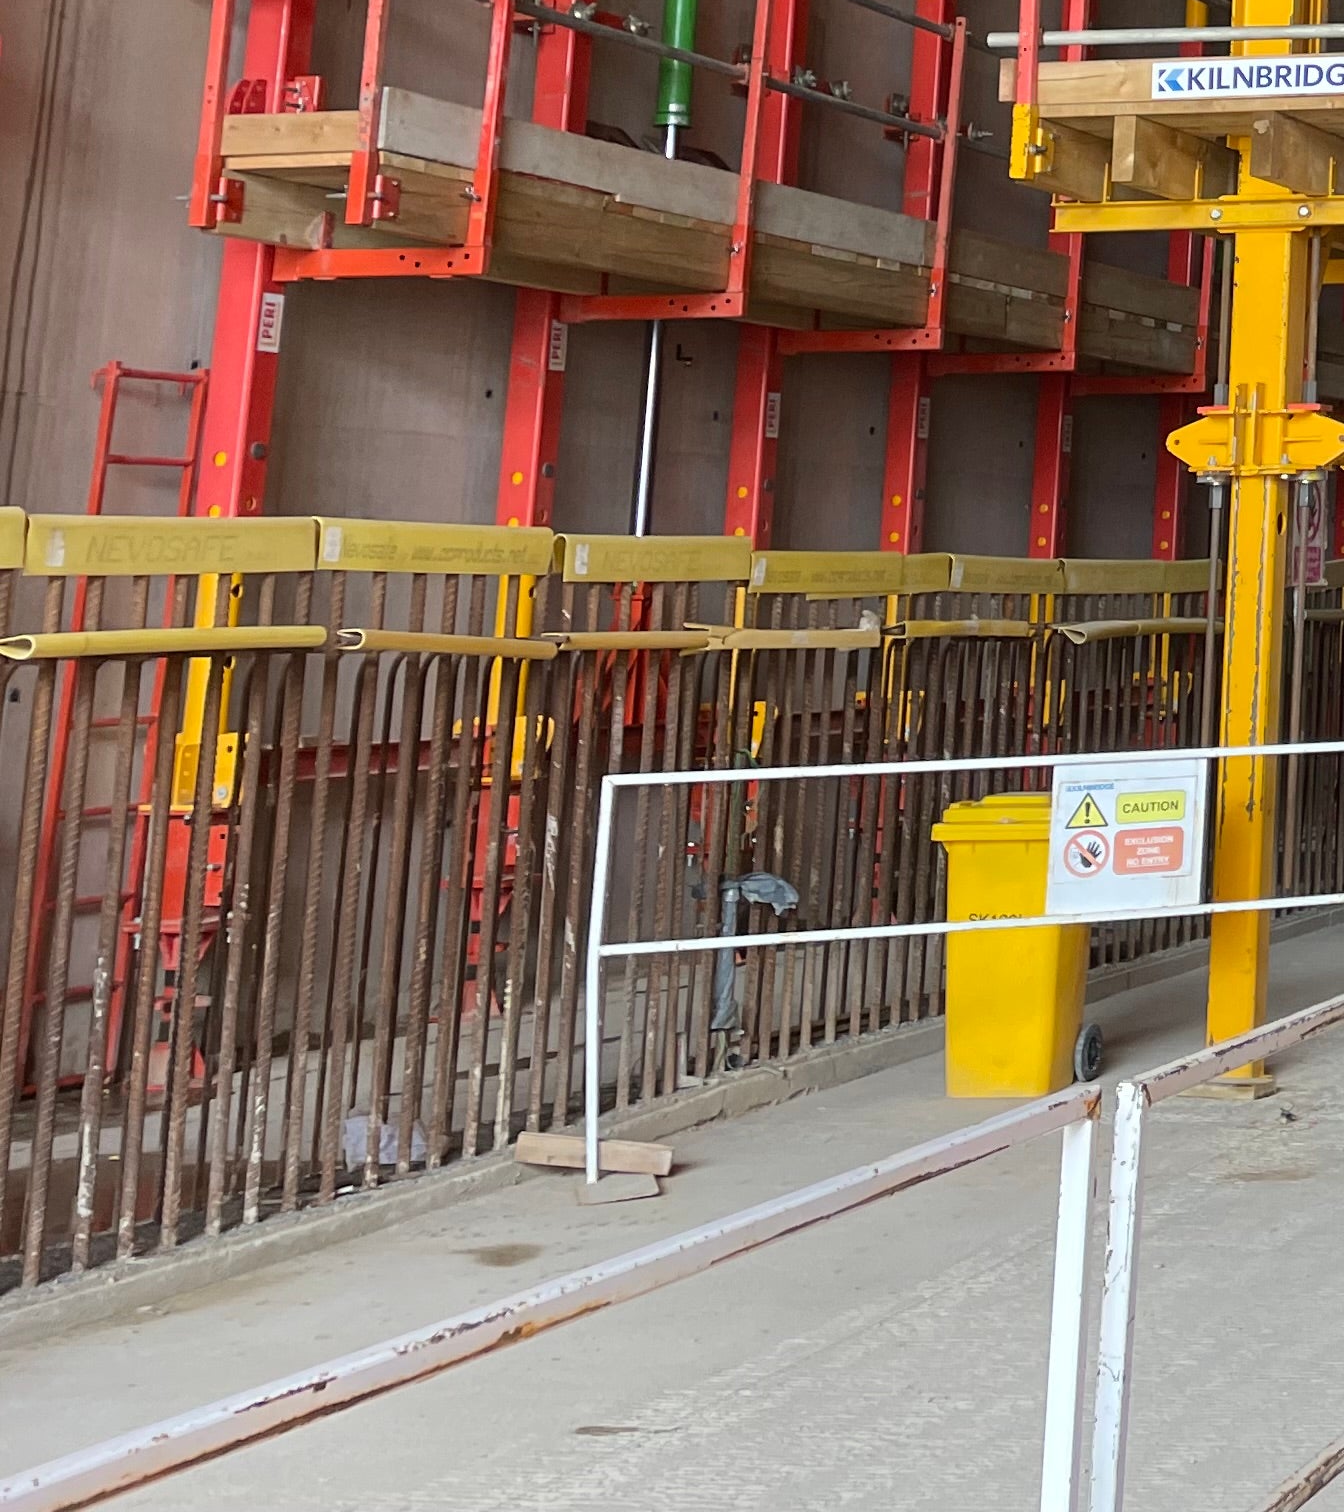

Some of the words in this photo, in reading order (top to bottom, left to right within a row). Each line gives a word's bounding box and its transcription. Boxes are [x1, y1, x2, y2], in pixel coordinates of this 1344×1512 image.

[261, 301, 276, 339] PERI
[86, 534, 240, 564] NEVOSAFE
[1122, 799, 1179, 815] CAUTION
